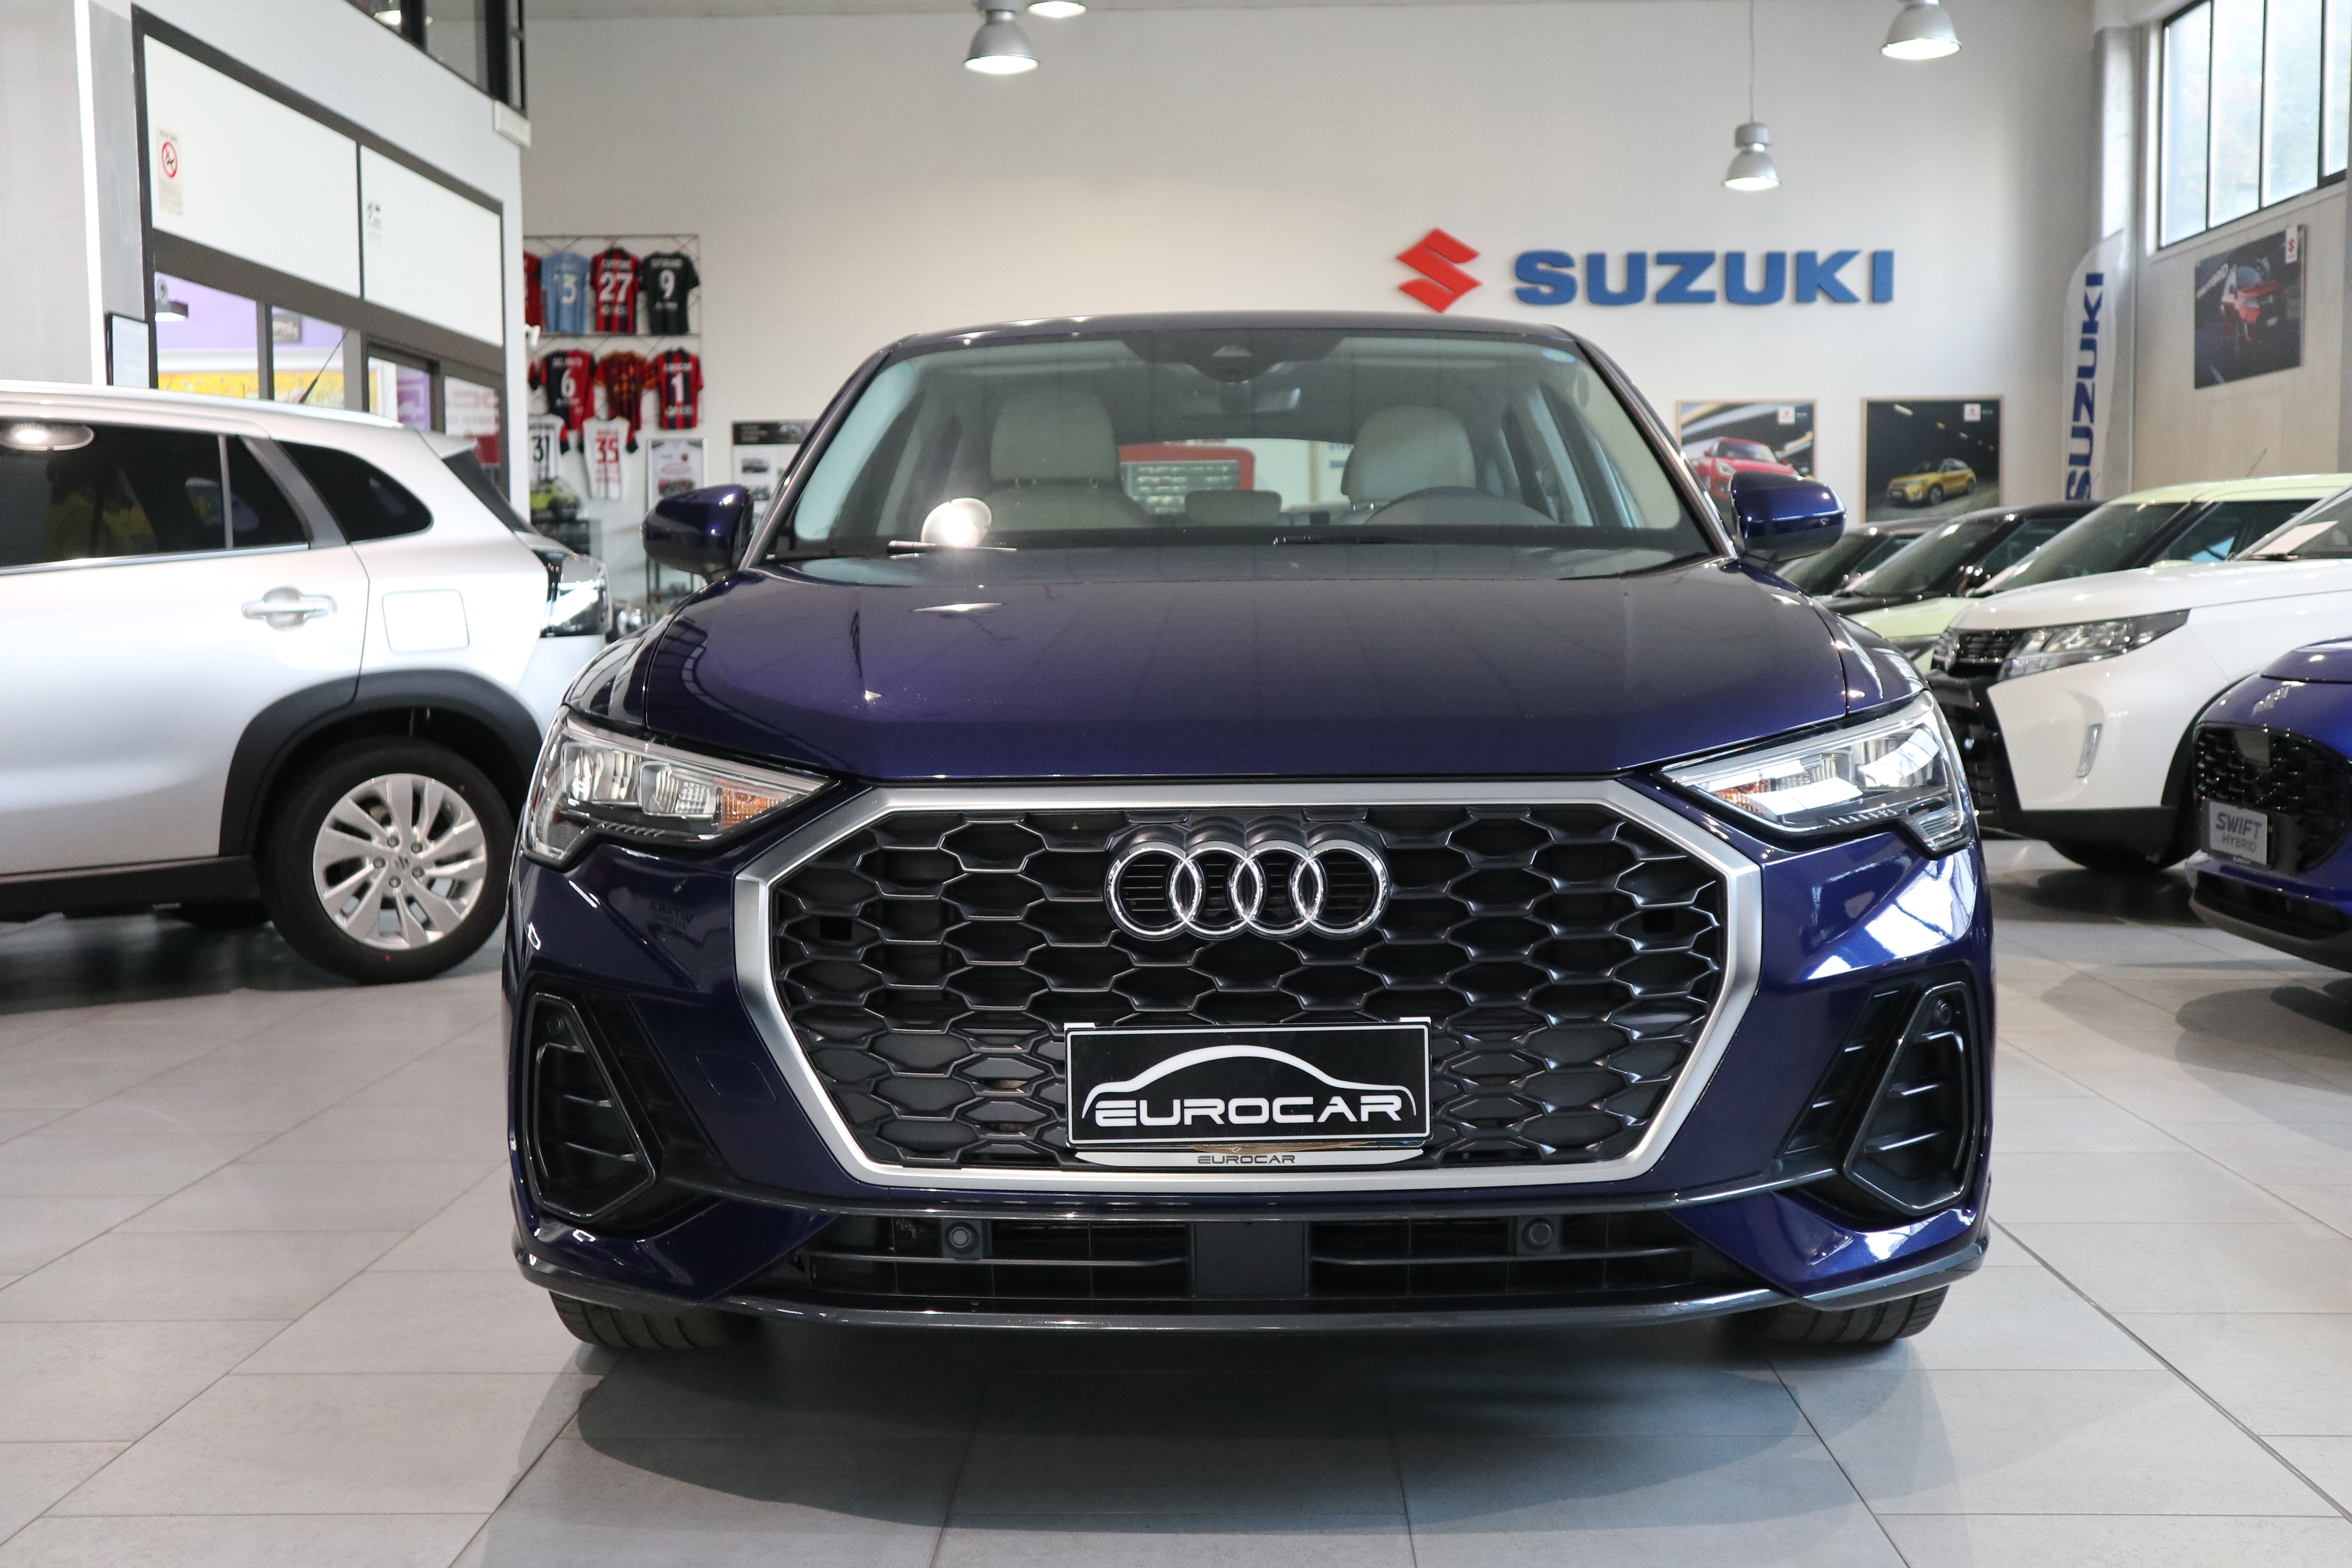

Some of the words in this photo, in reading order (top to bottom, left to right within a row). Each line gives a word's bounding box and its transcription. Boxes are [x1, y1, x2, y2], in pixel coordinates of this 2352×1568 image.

[599, 272, 633, 302] 27
[659, 269, 675, 299] 9
[1514, 249, 1895, 306] SUZUKI
[561, 368, 575, 397] 6
[671, 372, 684, 402] 1
[2067, 273, 2104, 501] SUZUKI
[532, 435, 549, 462] 31
[595, 437, 618, 463] 35
[2216, 812, 2262, 839] SWIFT
[2223, 834, 2257, 852] HYBRID
[1095, 1095, 1402, 1127] EUROCAR
[1197, 1155, 1296, 1164] EUROCAR
